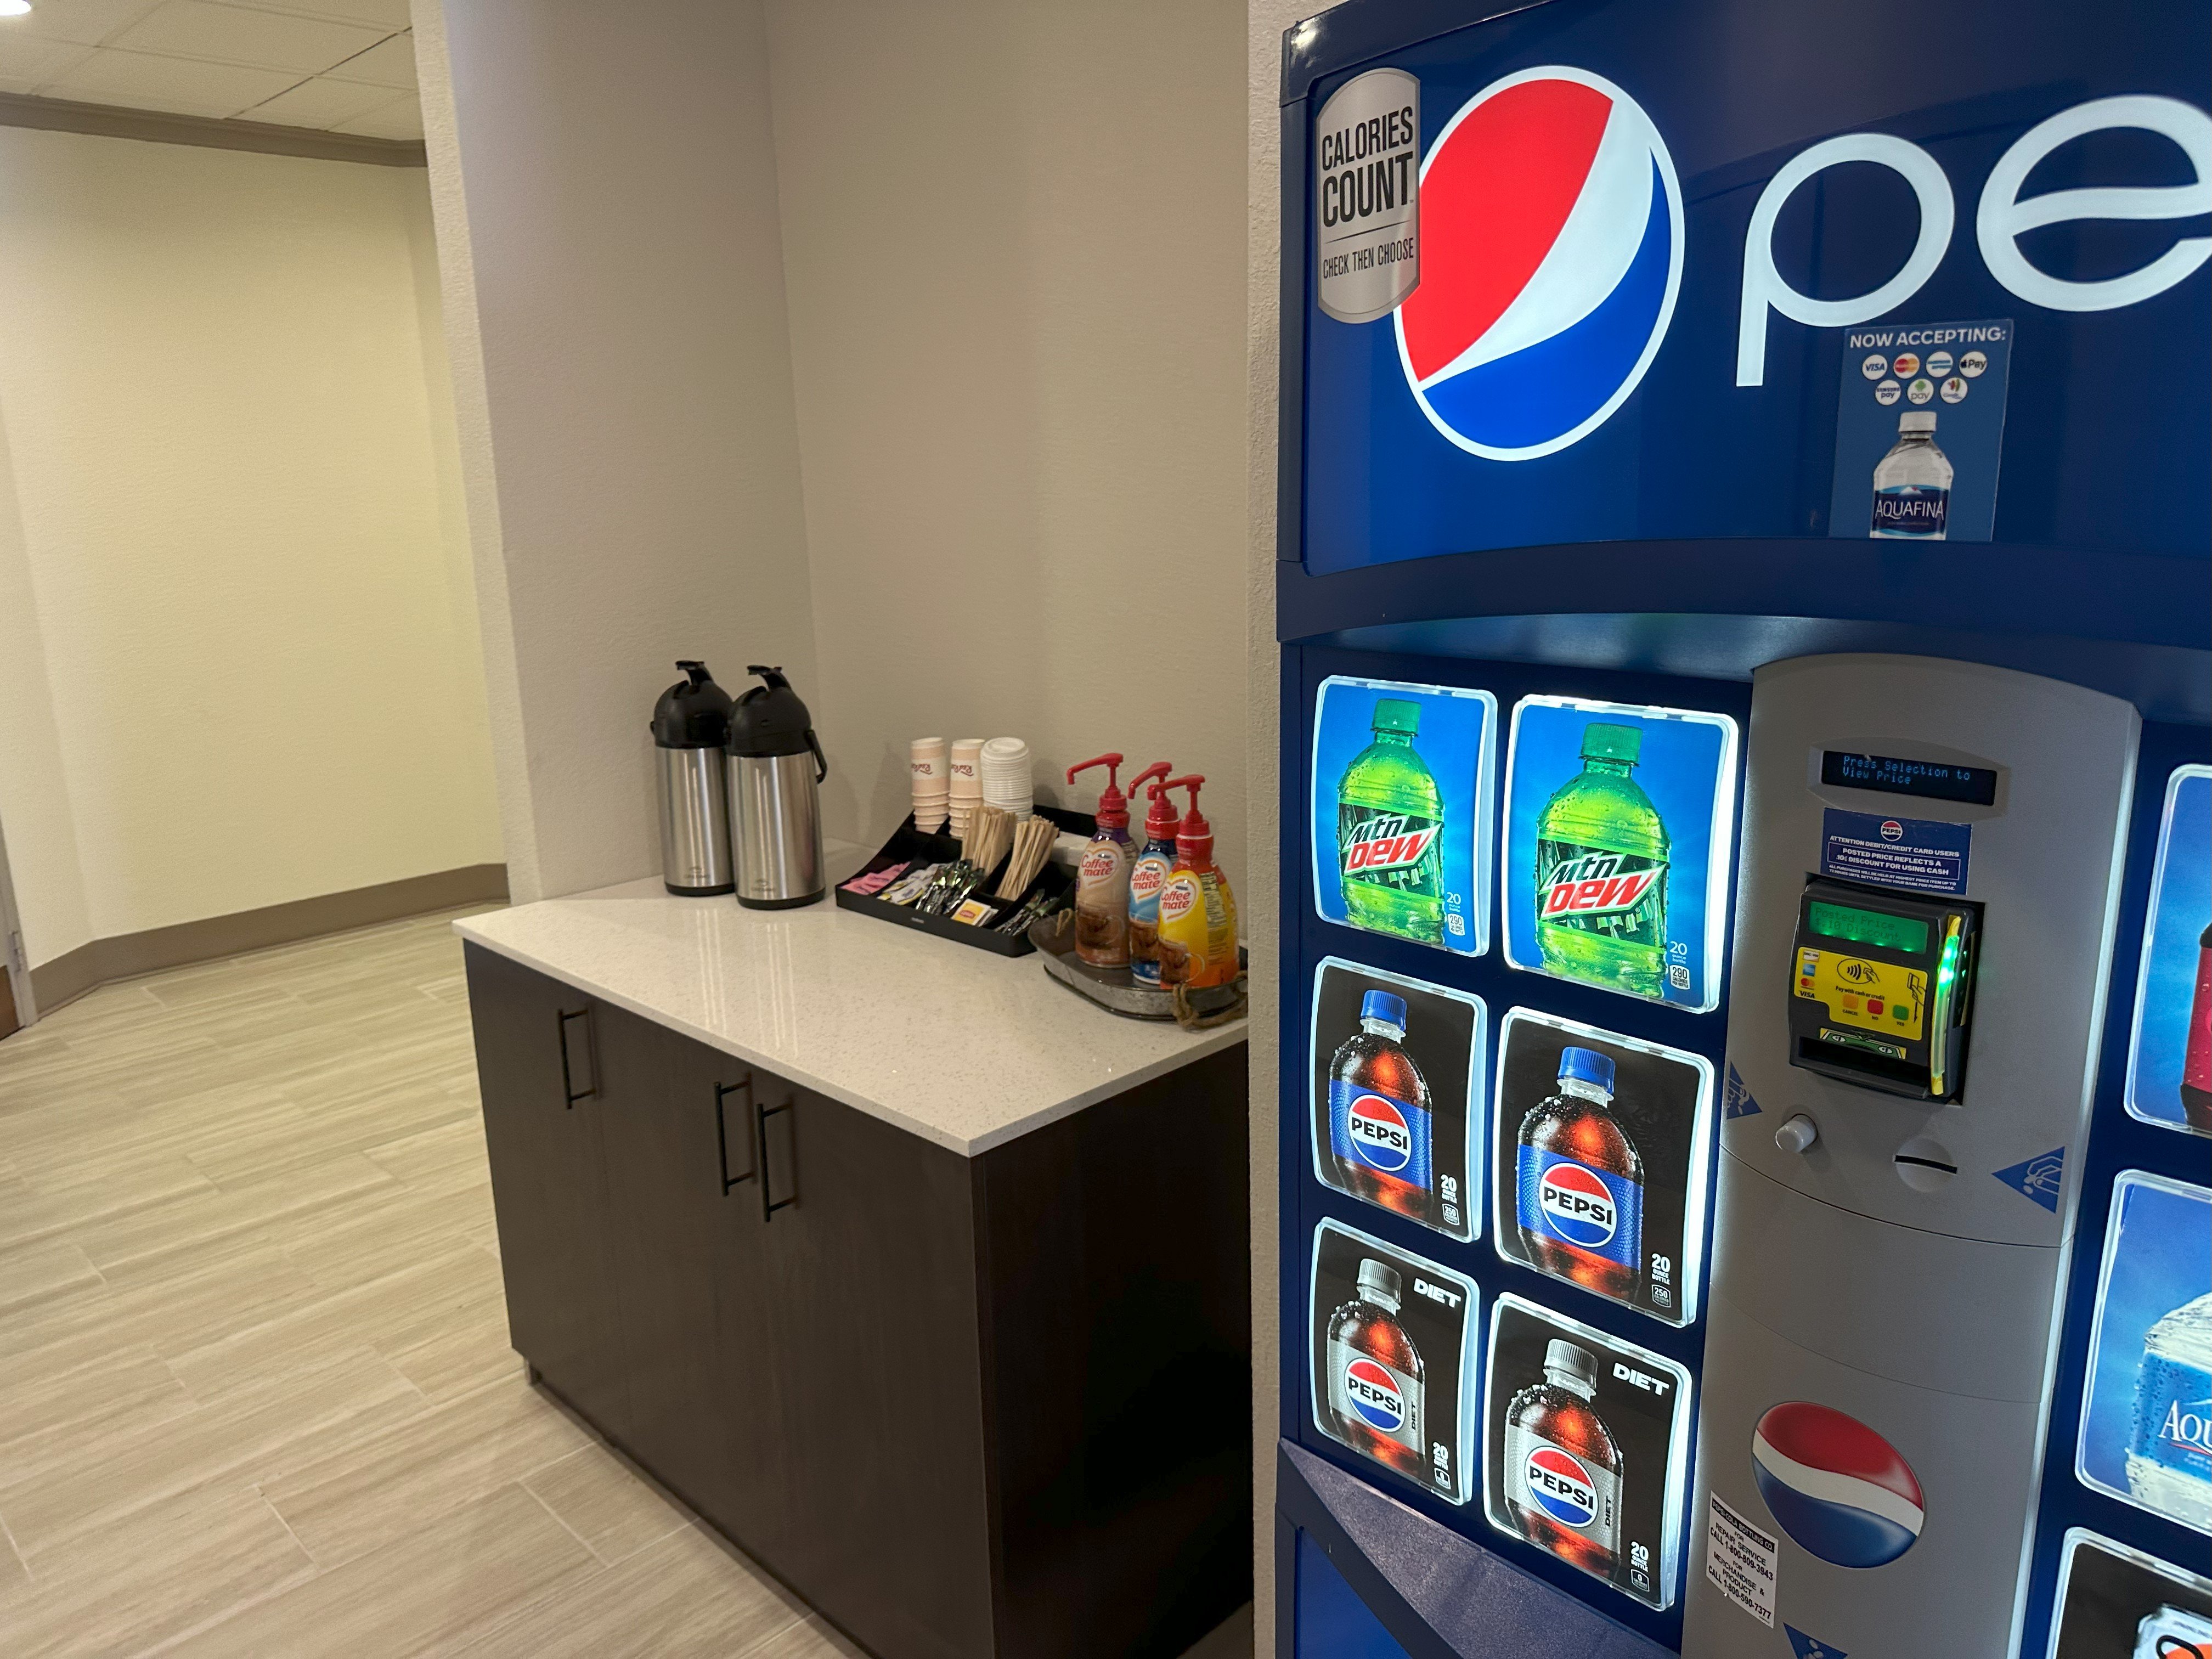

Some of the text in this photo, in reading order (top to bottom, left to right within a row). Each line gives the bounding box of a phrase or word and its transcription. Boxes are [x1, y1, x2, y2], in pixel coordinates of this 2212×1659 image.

[1322, 106, 1413, 171] CALORIES
[1323, 151, 1414, 227] COUNT
[1323, 238, 1414, 279] CHECK THEN CHOOSE
[1850, 327, 2006, 348] NOW ACCEPTING:
[1865, 363, 1885, 372] VISA
[1968, 359, 1987, 370] Pay
[1911, 392, 1930, 400] pay
[1875, 500, 1944, 521] AQUAFINA
[1843, 755, 1970, 781] Press Selection to
[1843, 766, 1911, 785] View Price
[1830, 835, 1865, 846] ATTENTION
[1865, 841, 1912, 853] DEBIT/CREDIT
[1081, 854, 1114, 868] Coffee
[1843, 848, 1871, 857] POSTED
[1871, 853, 1894, 861] PRICE
[1894, 856, 1934, 866] REFLECTS
[1848, 856, 1885, 867] DISCOUNT
[1926, 867, 1949, 876] CASH
[1084, 867, 1113, 876] mate
[1133, 880, 1160, 890] mate
[1162, 900, 1190, 910] mate
[1447, 891, 1462, 905] 20
[1450, 915, 1462, 926] 290
[1815, 907, 1895, 930] Posted Price
[1847, 923, 1900, 941] Discount
[1669, 941, 1688, 955] 20
[1672, 967, 1688, 979] 290
[1799, 990, 1815, 998] VISA
[1351, 1116, 1408, 1150] PEPSI
[1441, 1174, 1457, 1192] 20
[1444, 1206, 1457, 1217] 250
[1543, 1186, 1612, 1226] PEPSI
[1651, 1253, 1671, 1273] 20
[1651, 1273, 1670, 1285] BOTTLE
[1413, 1278, 1461, 1308] DIET
[1654, 1286, 1668, 1299] 250
[1612, 1362, 1669, 1396] DIET
[1348, 1376, 1402, 1415] PEPSI
[1433, 1442, 1448, 1460] 20
[1530, 1465, 1594, 1510] PEPSI
[1712, 1501, 1737, 1527] PEPSI-COLA
[1738, 1523, 1764, 1545] BOTTLING
[1716, 1522, 1767, 1566] REPAIR SERVICE
[1734, 1531, 1744, 1542] FOR
[1630, 1541, 1649, 1561] 20
[1710, 1527, 1773, 1581] CALL 1-800-809-3943
[1713, 1551, 1765, 1596] MERCHANDISE &
[1733, 1560, 1742, 1571] FOR
[1723, 1568, 1752, 1596] PRODUCT
[1708, 1565, 1771, 1620] CALL 1-800-590-7377
